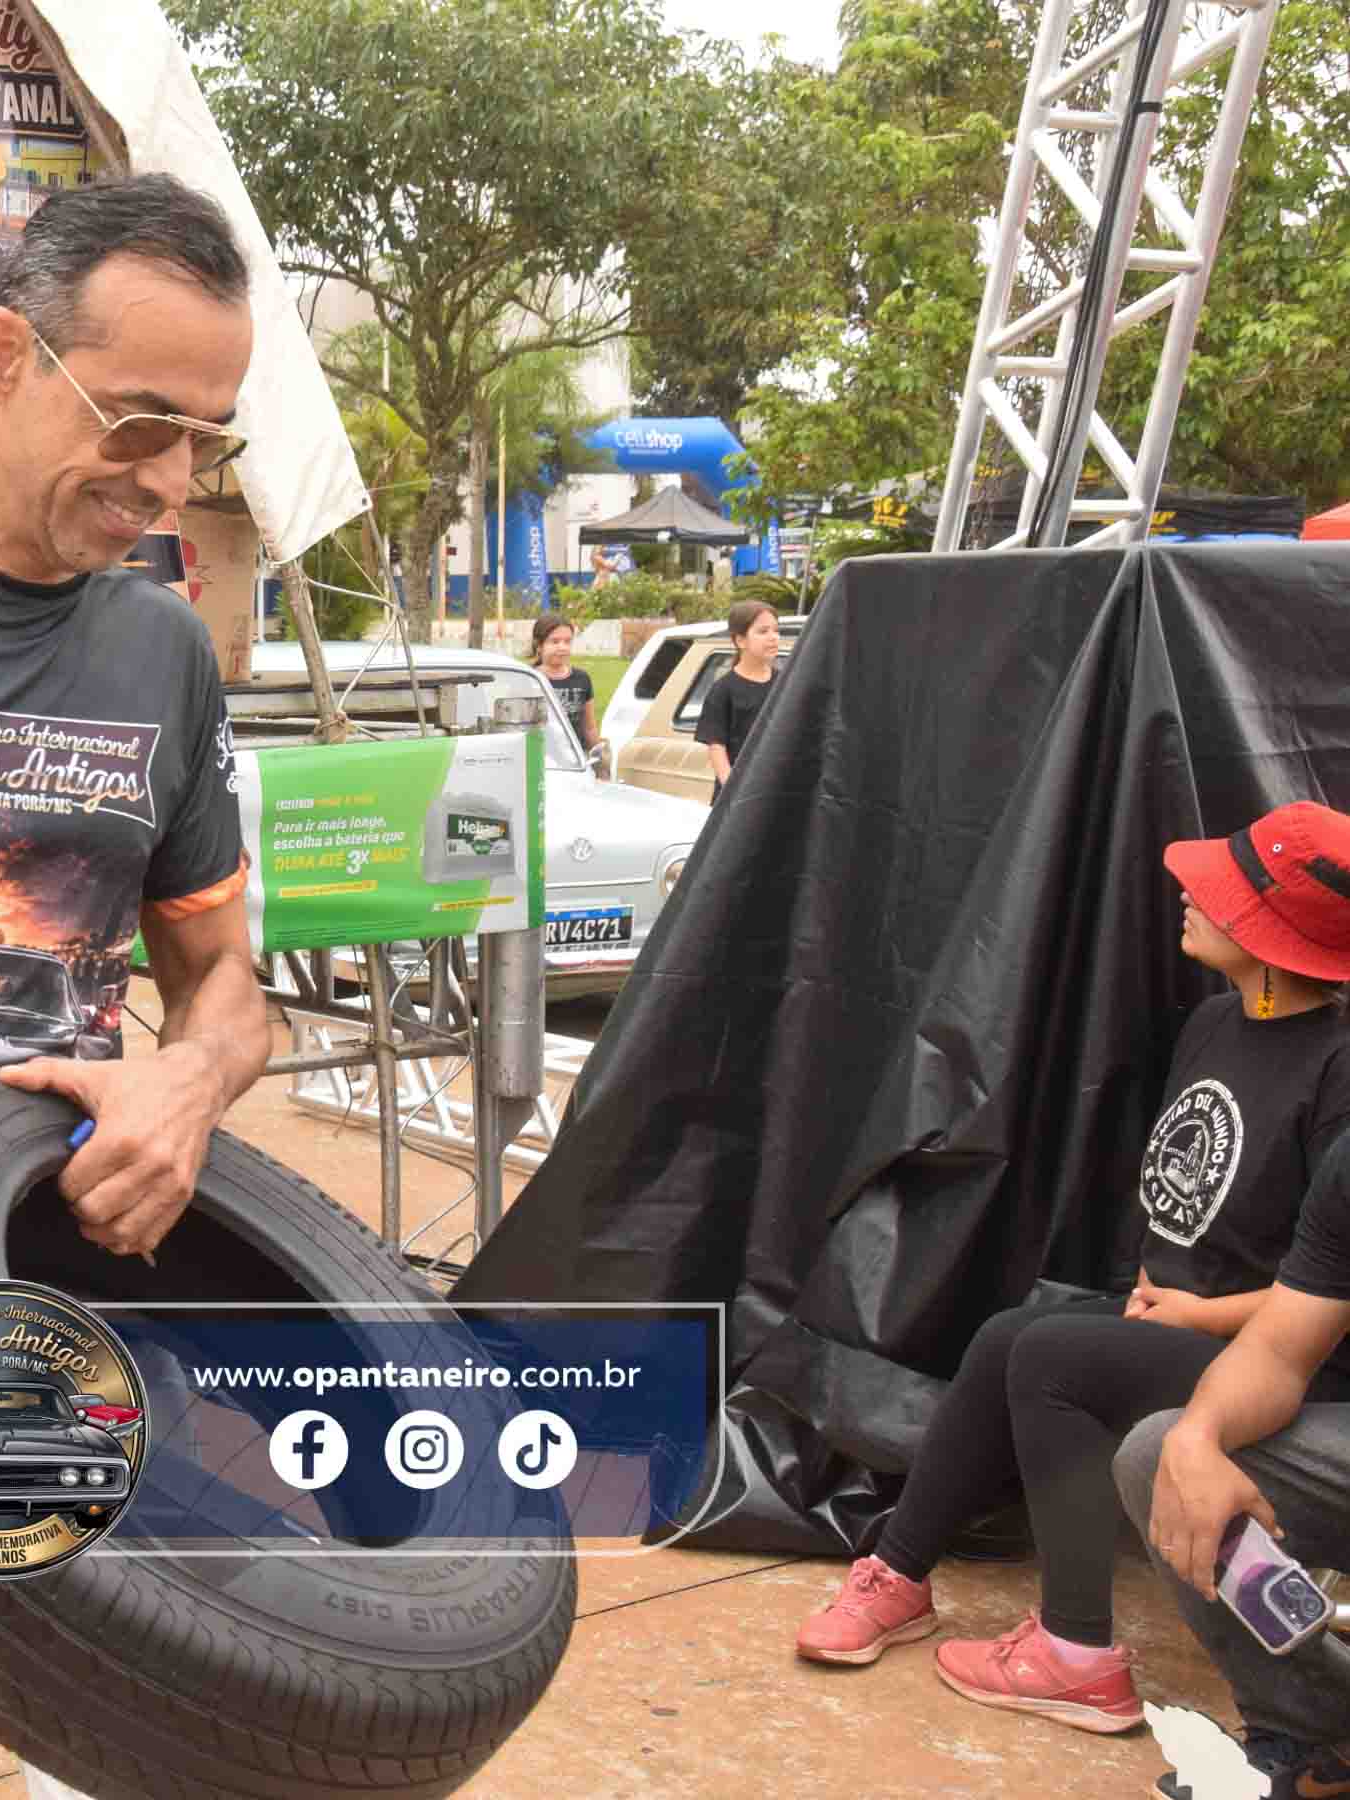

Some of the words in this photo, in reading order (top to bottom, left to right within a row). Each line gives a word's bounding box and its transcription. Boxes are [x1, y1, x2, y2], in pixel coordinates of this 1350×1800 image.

[18, 720, 141, 760] Internacional
[8, 747, 146, 813] Antigos
[273, 821, 303, 834] Para
[305, 818, 316, 833] ir
[317, 817, 347, 832] mais
[273, 836, 323, 850] escolha
[324, 837, 333, 847] a
[335, 831, 379, 847] bateria
[381, 831, 405, 845] que
[546, 917, 622, 943] RV4C71
[1210, 1104, 1230, 1164] MUNDO
